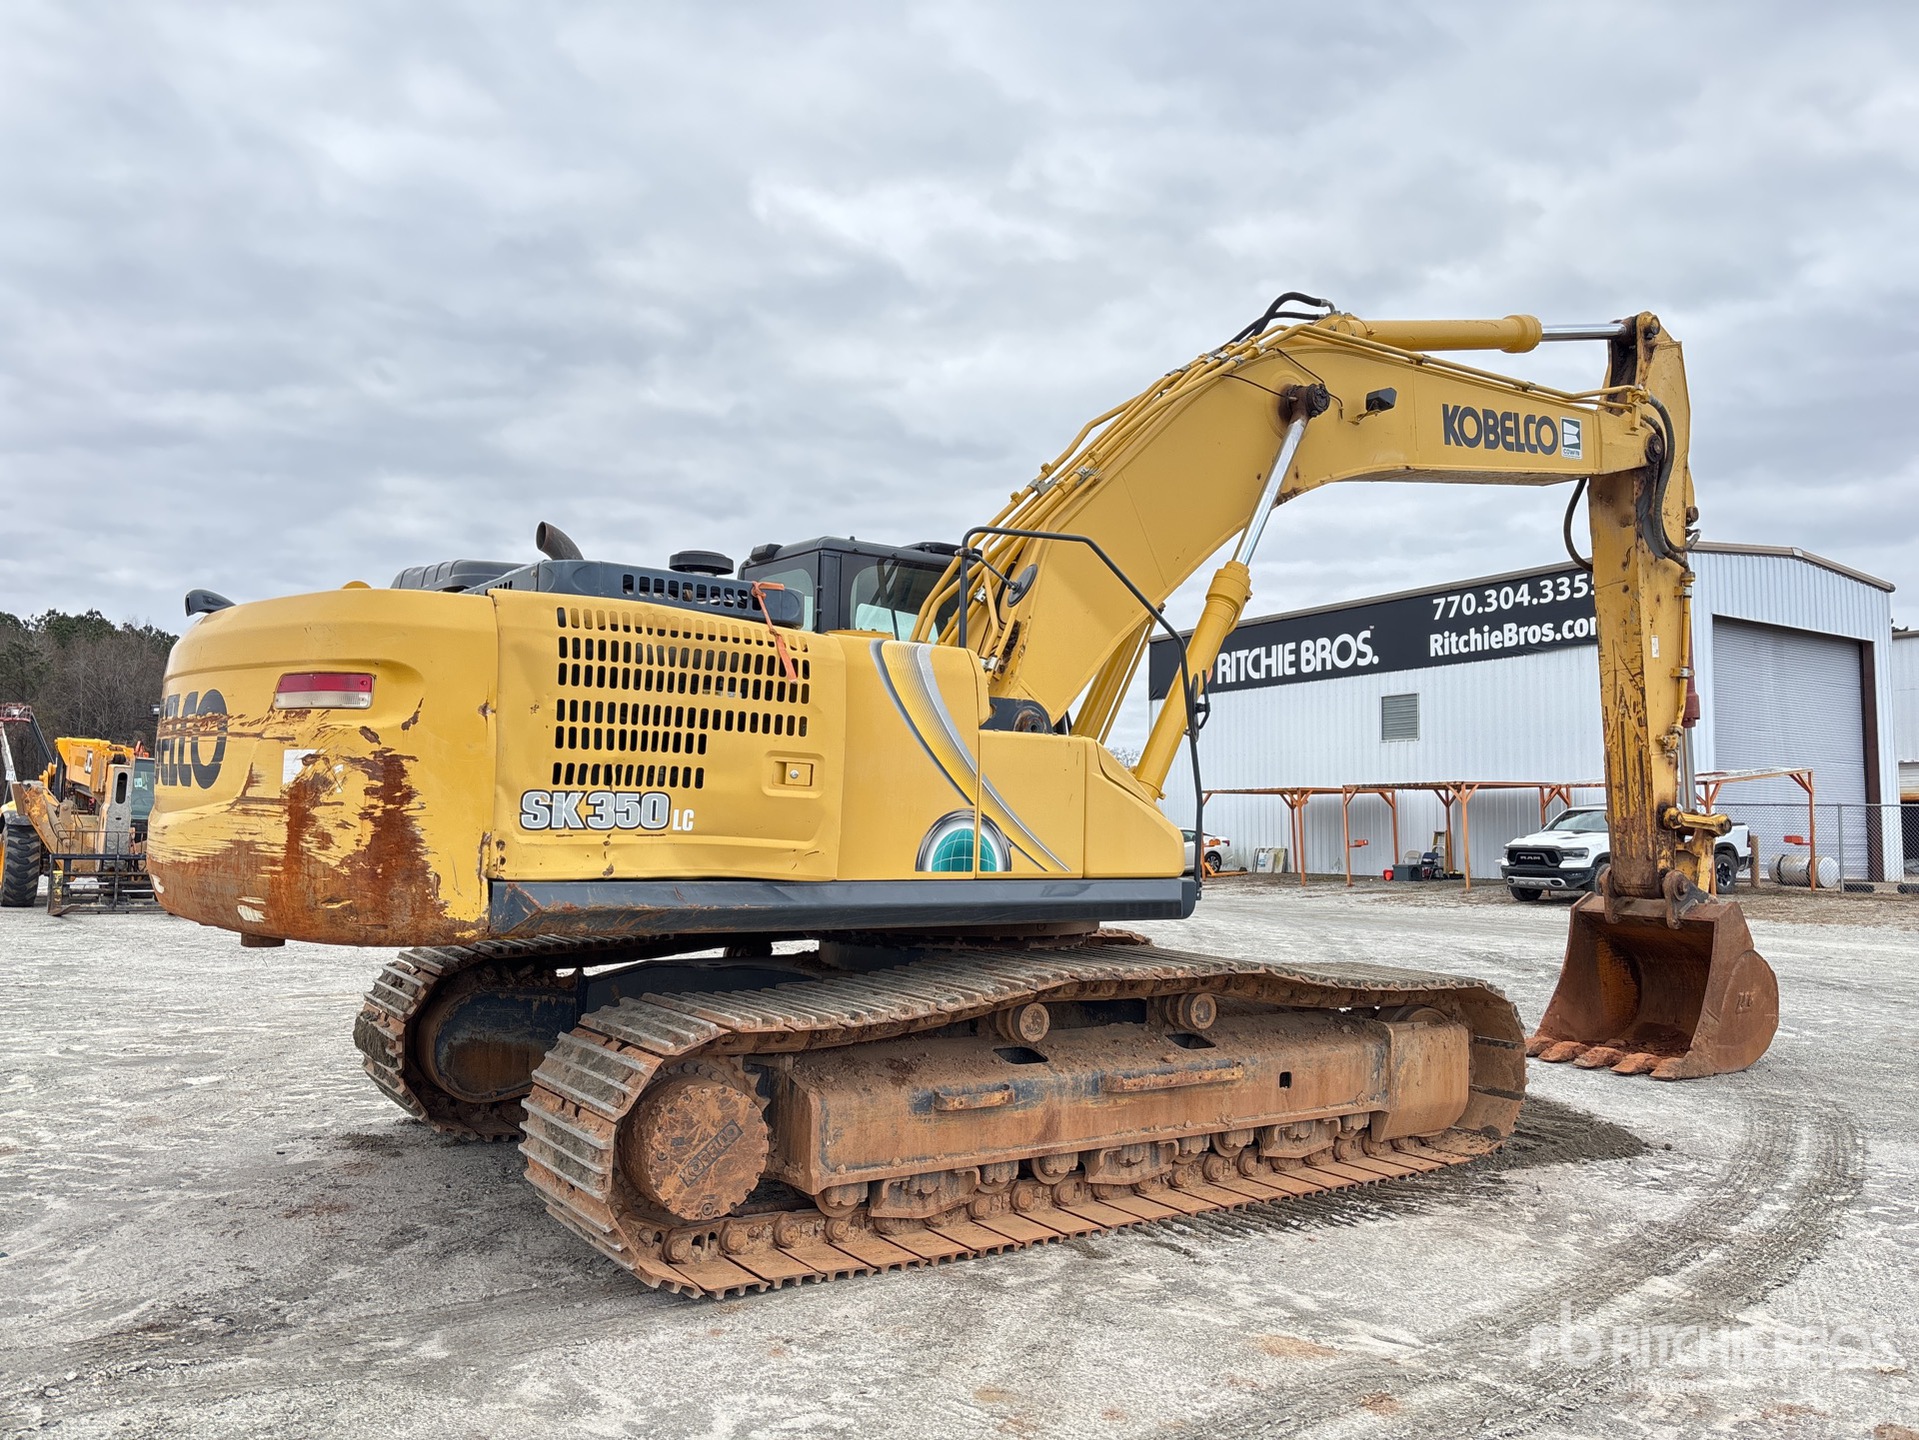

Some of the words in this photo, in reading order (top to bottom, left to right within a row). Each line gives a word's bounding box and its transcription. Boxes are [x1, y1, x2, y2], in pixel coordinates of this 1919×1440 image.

[1442, 403, 1559, 456] KOBELCO
[1217, 642, 1297, 684] RITCHIE
[520, 789, 672, 831] SK350
[672, 809, 695, 832] LC
